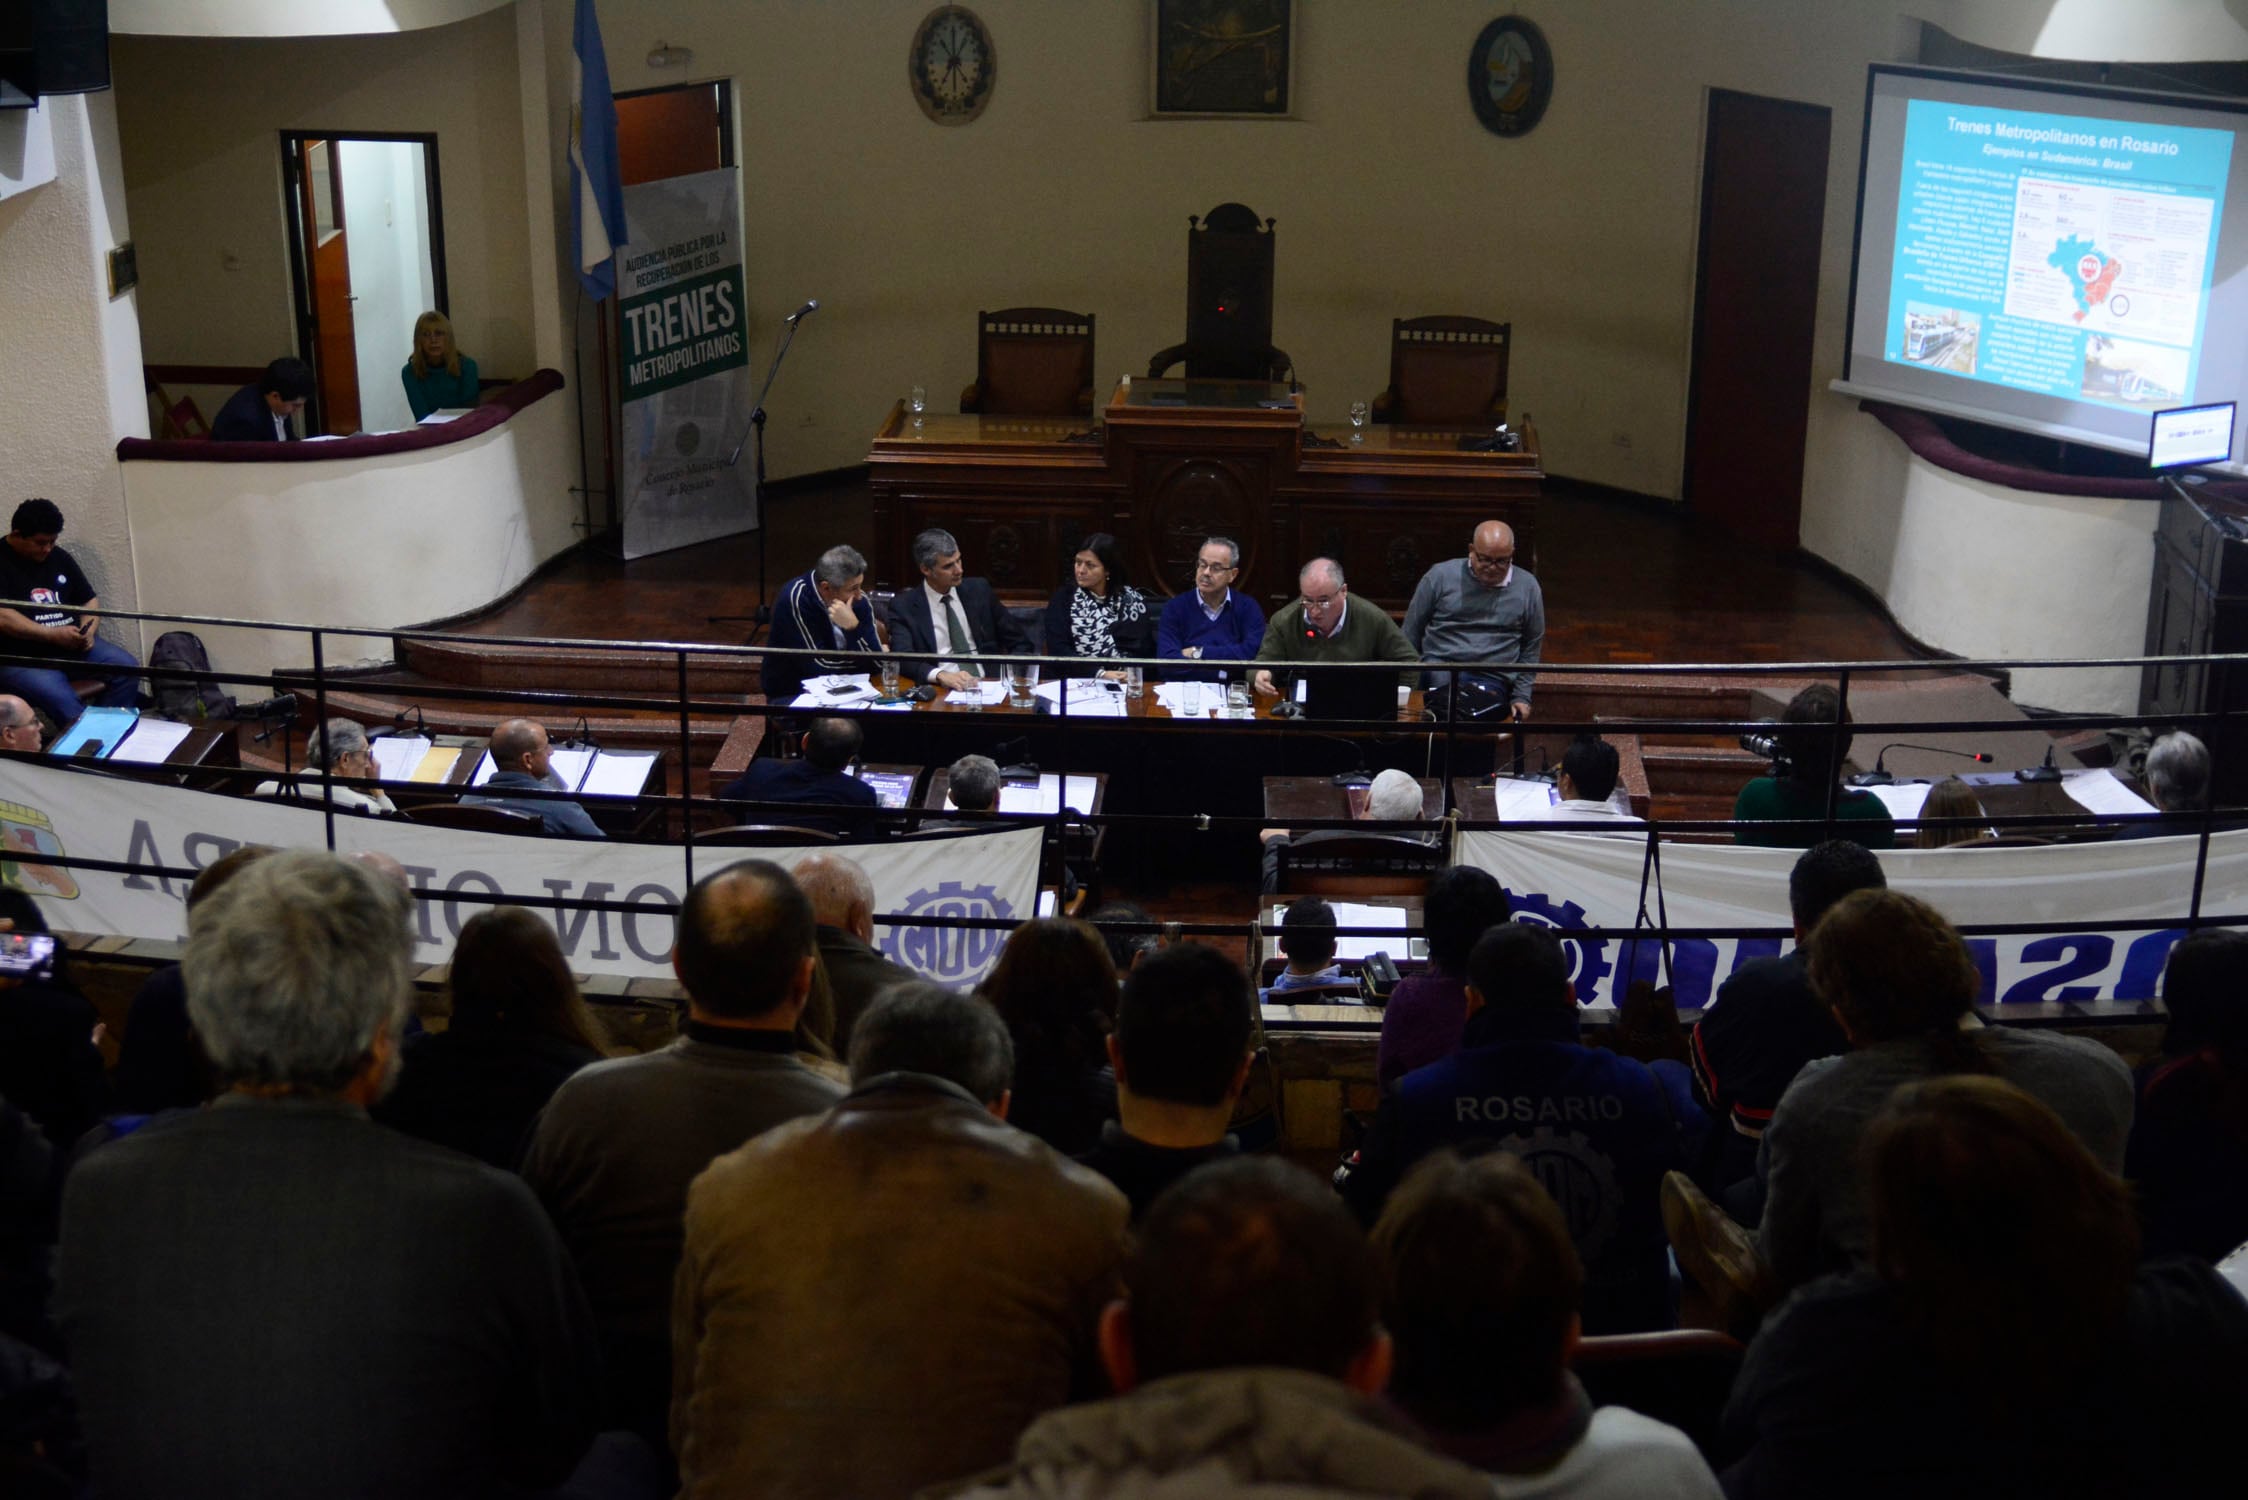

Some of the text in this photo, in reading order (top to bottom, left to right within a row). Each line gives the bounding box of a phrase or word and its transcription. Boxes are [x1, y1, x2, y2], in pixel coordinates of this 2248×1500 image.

[1947, 116, 2179, 156] Trenes Metropolitanos en Rosario
[2027, 151, 2040, 160] en
[2102, 158, 2133, 171] Brasil
[625, 248, 668, 273] AUDIENCIA
[700, 234, 716, 250] POR
[716, 230, 727, 246] LA
[694, 255, 705, 270] DE
[705, 250, 720, 267] LOS
[625, 280, 737, 356] TRENES
[630, 332, 741, 387] METROPOLITANOS
[35, 612, 64, 621] PARTIDO
[1455, 1095, 1624, 1122] ROSARIO
